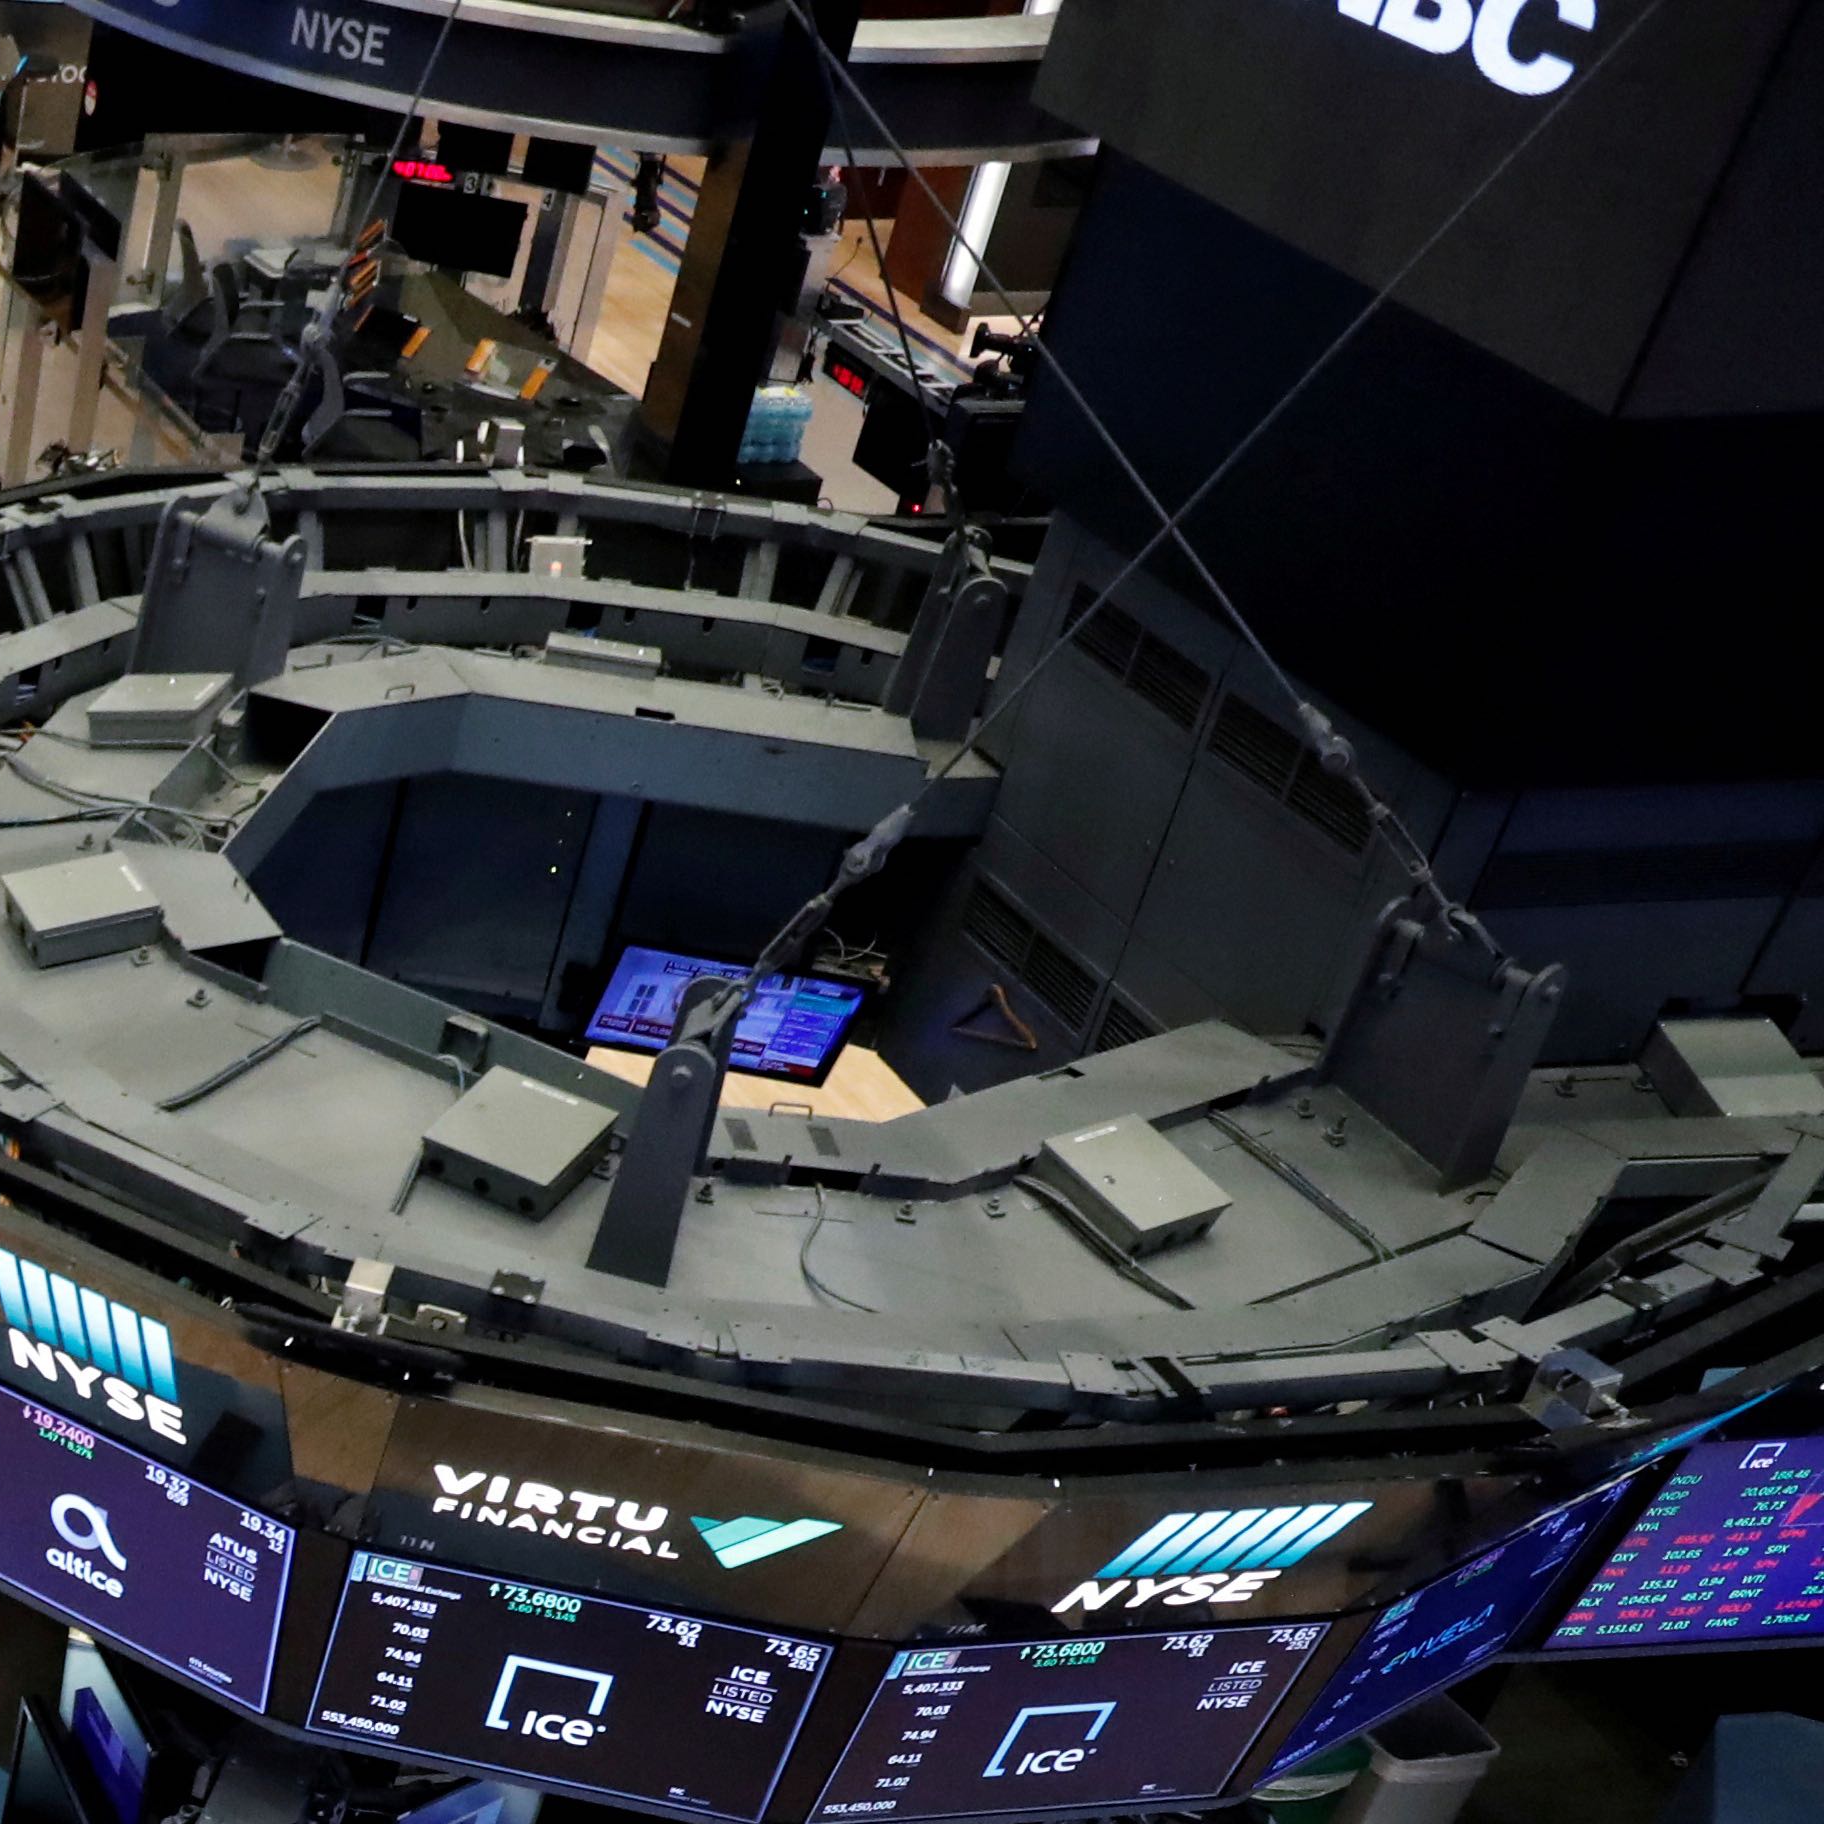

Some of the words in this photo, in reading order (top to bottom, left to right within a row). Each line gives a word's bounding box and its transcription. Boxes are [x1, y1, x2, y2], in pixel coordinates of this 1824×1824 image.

[290, 7, 390, 66] NYSE
[8, 1327, 188, 1445] NYSE
[33, 1408, 95, 1450] 19.2400
[145, 1464, 191, 1495] 19.32
[433, 1464, 670, 1532] VIRTU
[1646, 1506, 1681, 1517] NYSE
[239, 1510, 286, 1544] 19.34
[431, 1496, 680, 1561] FINANCIAL
[208, 1532, 259, 1565] ATUS
[1610, 1552, 1639, 1563] DXY
[45, 1547, 125, 1599] altice
[206, 1550, 256, 1583] LISTED
[367, 1557, 411, 1582] ICE
[203, 1568, 253, 1603] NYSE
[1050, 1569, 1282, 1614] NYSE
[370, 1591, 438, 1615] 5,407,333
[502, 1583, 582, 1615] 73.6800
[391, 1621, 430, 1640] 70.03
[645, 1614, 703, 1639] 73.62
[1267, 1626, 1322, 1645] 73.65
[1555, 1626, 1587, 1637] FTSE
[763, 1638, 823, 1663] 73.65
[1030, 1640, 1106, 1661] 73.6800
[1161, 1633, 1215, 1651] 73.62
[384, 1646, 423, 1664] 74.94
[907, 1651, 947, 1670] ICE
[729, 1664, 772, 1687] ICE
[1228, 1660, 1267, 1675] ICE
[376, 1671, 414, 1689] 64.11
[902, 1681, 965, 1696] 5,407,333
[1207, 1678, 1263, 1693] LISTED
[369, 1694, 408, 1712] 71.02
[712, 1682, 774, 1705] LISTED
[1195, 1694, 1253, 1711] NYSE
[321, 1709, 401, 1736] 553,450,000
[704, 1699, 769, 1725] NYSE
[873, 1776, 910, 1789] 71.02
[822, 1800, 897, 1816] 553,450,000
